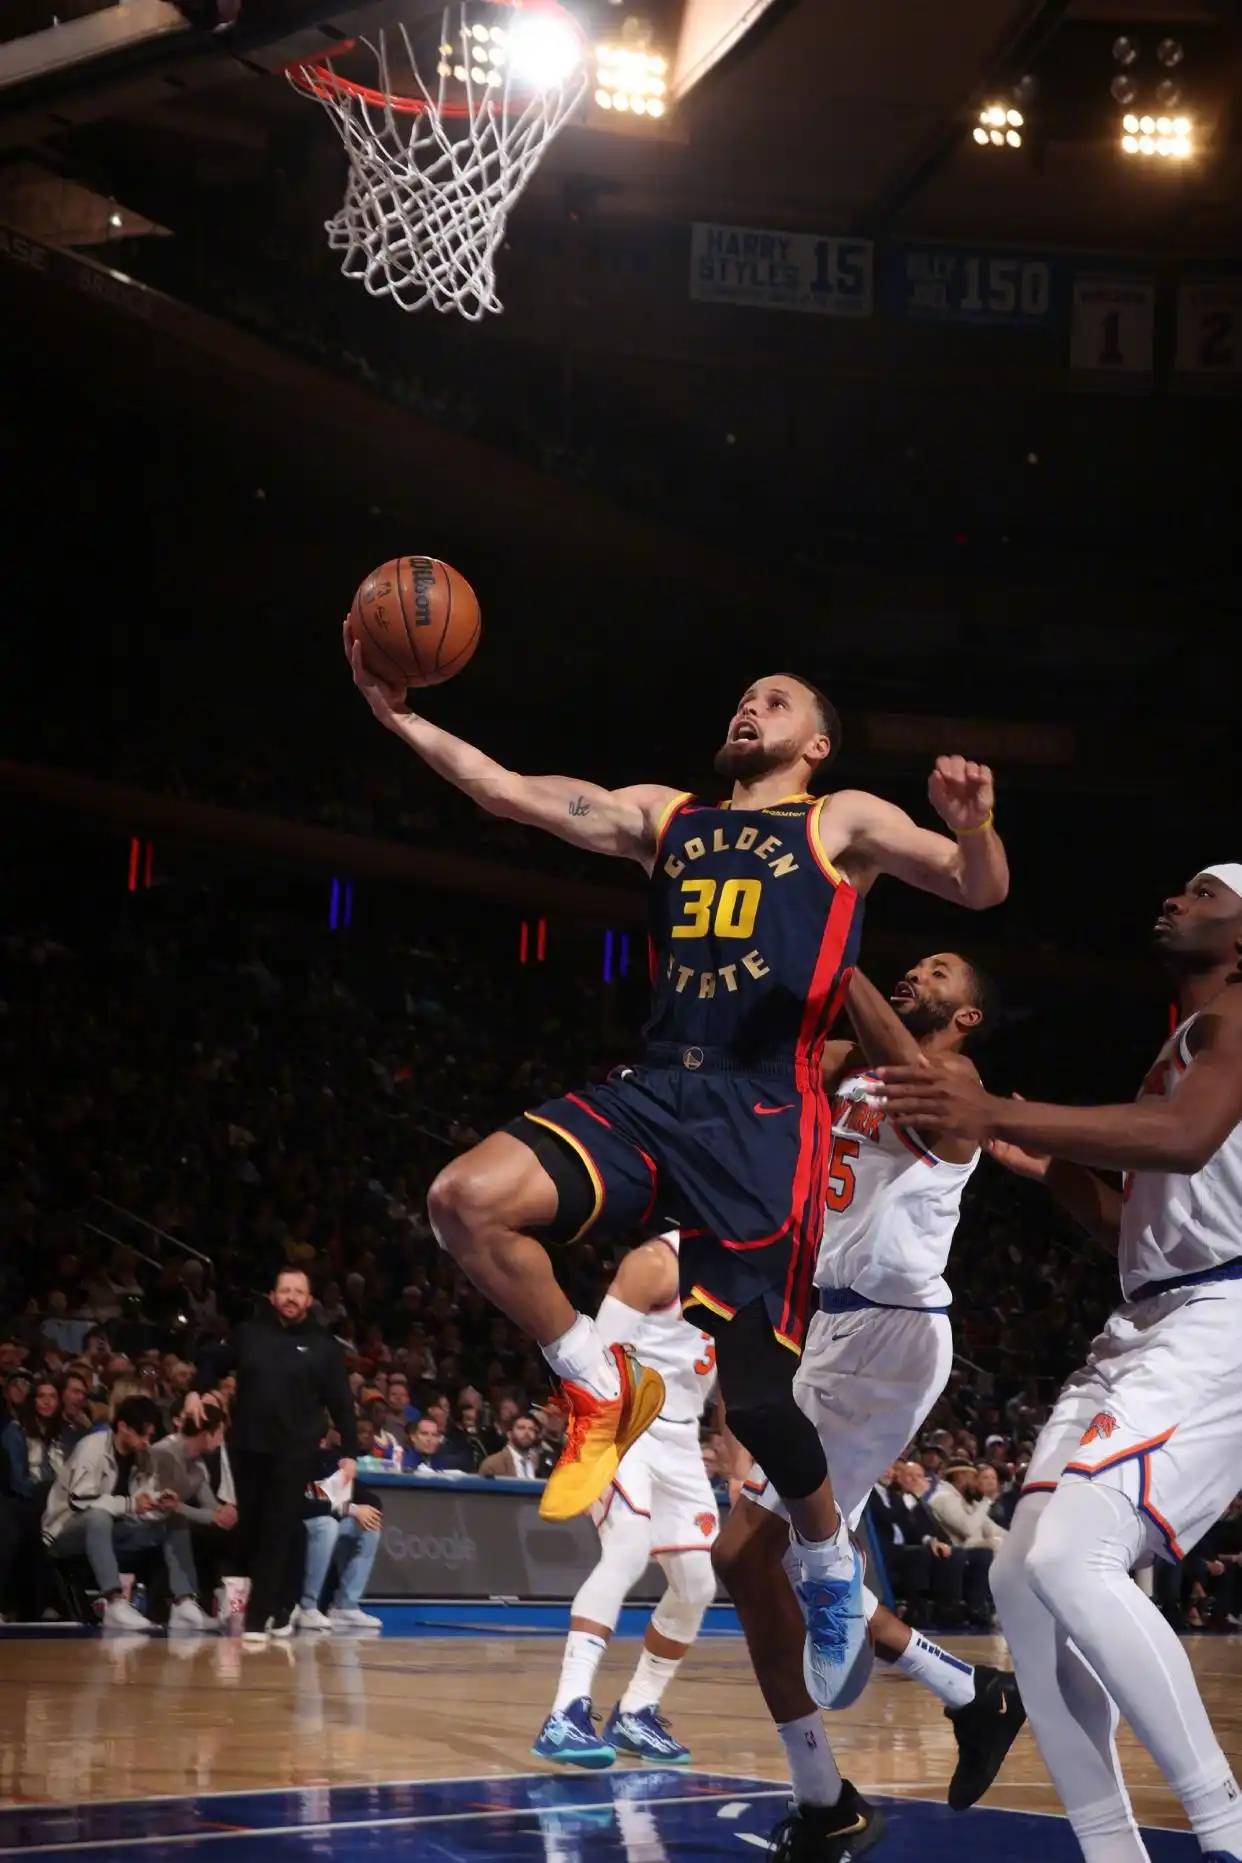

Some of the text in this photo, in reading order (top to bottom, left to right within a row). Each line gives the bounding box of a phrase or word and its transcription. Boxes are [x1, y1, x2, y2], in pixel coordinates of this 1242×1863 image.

[699, 250, 800, 289] STYLES
[708, 230, 793, 260] HARRY
[811, 241, 866, 294] 15
[960, 257, 1049, 315] 150
[1098, 311, 1123, 365] 1
[664, 825, 800, 880] GOLDEN
[670, 877, 762, 940] 30
[383, 1525, 477, 1571] Google
